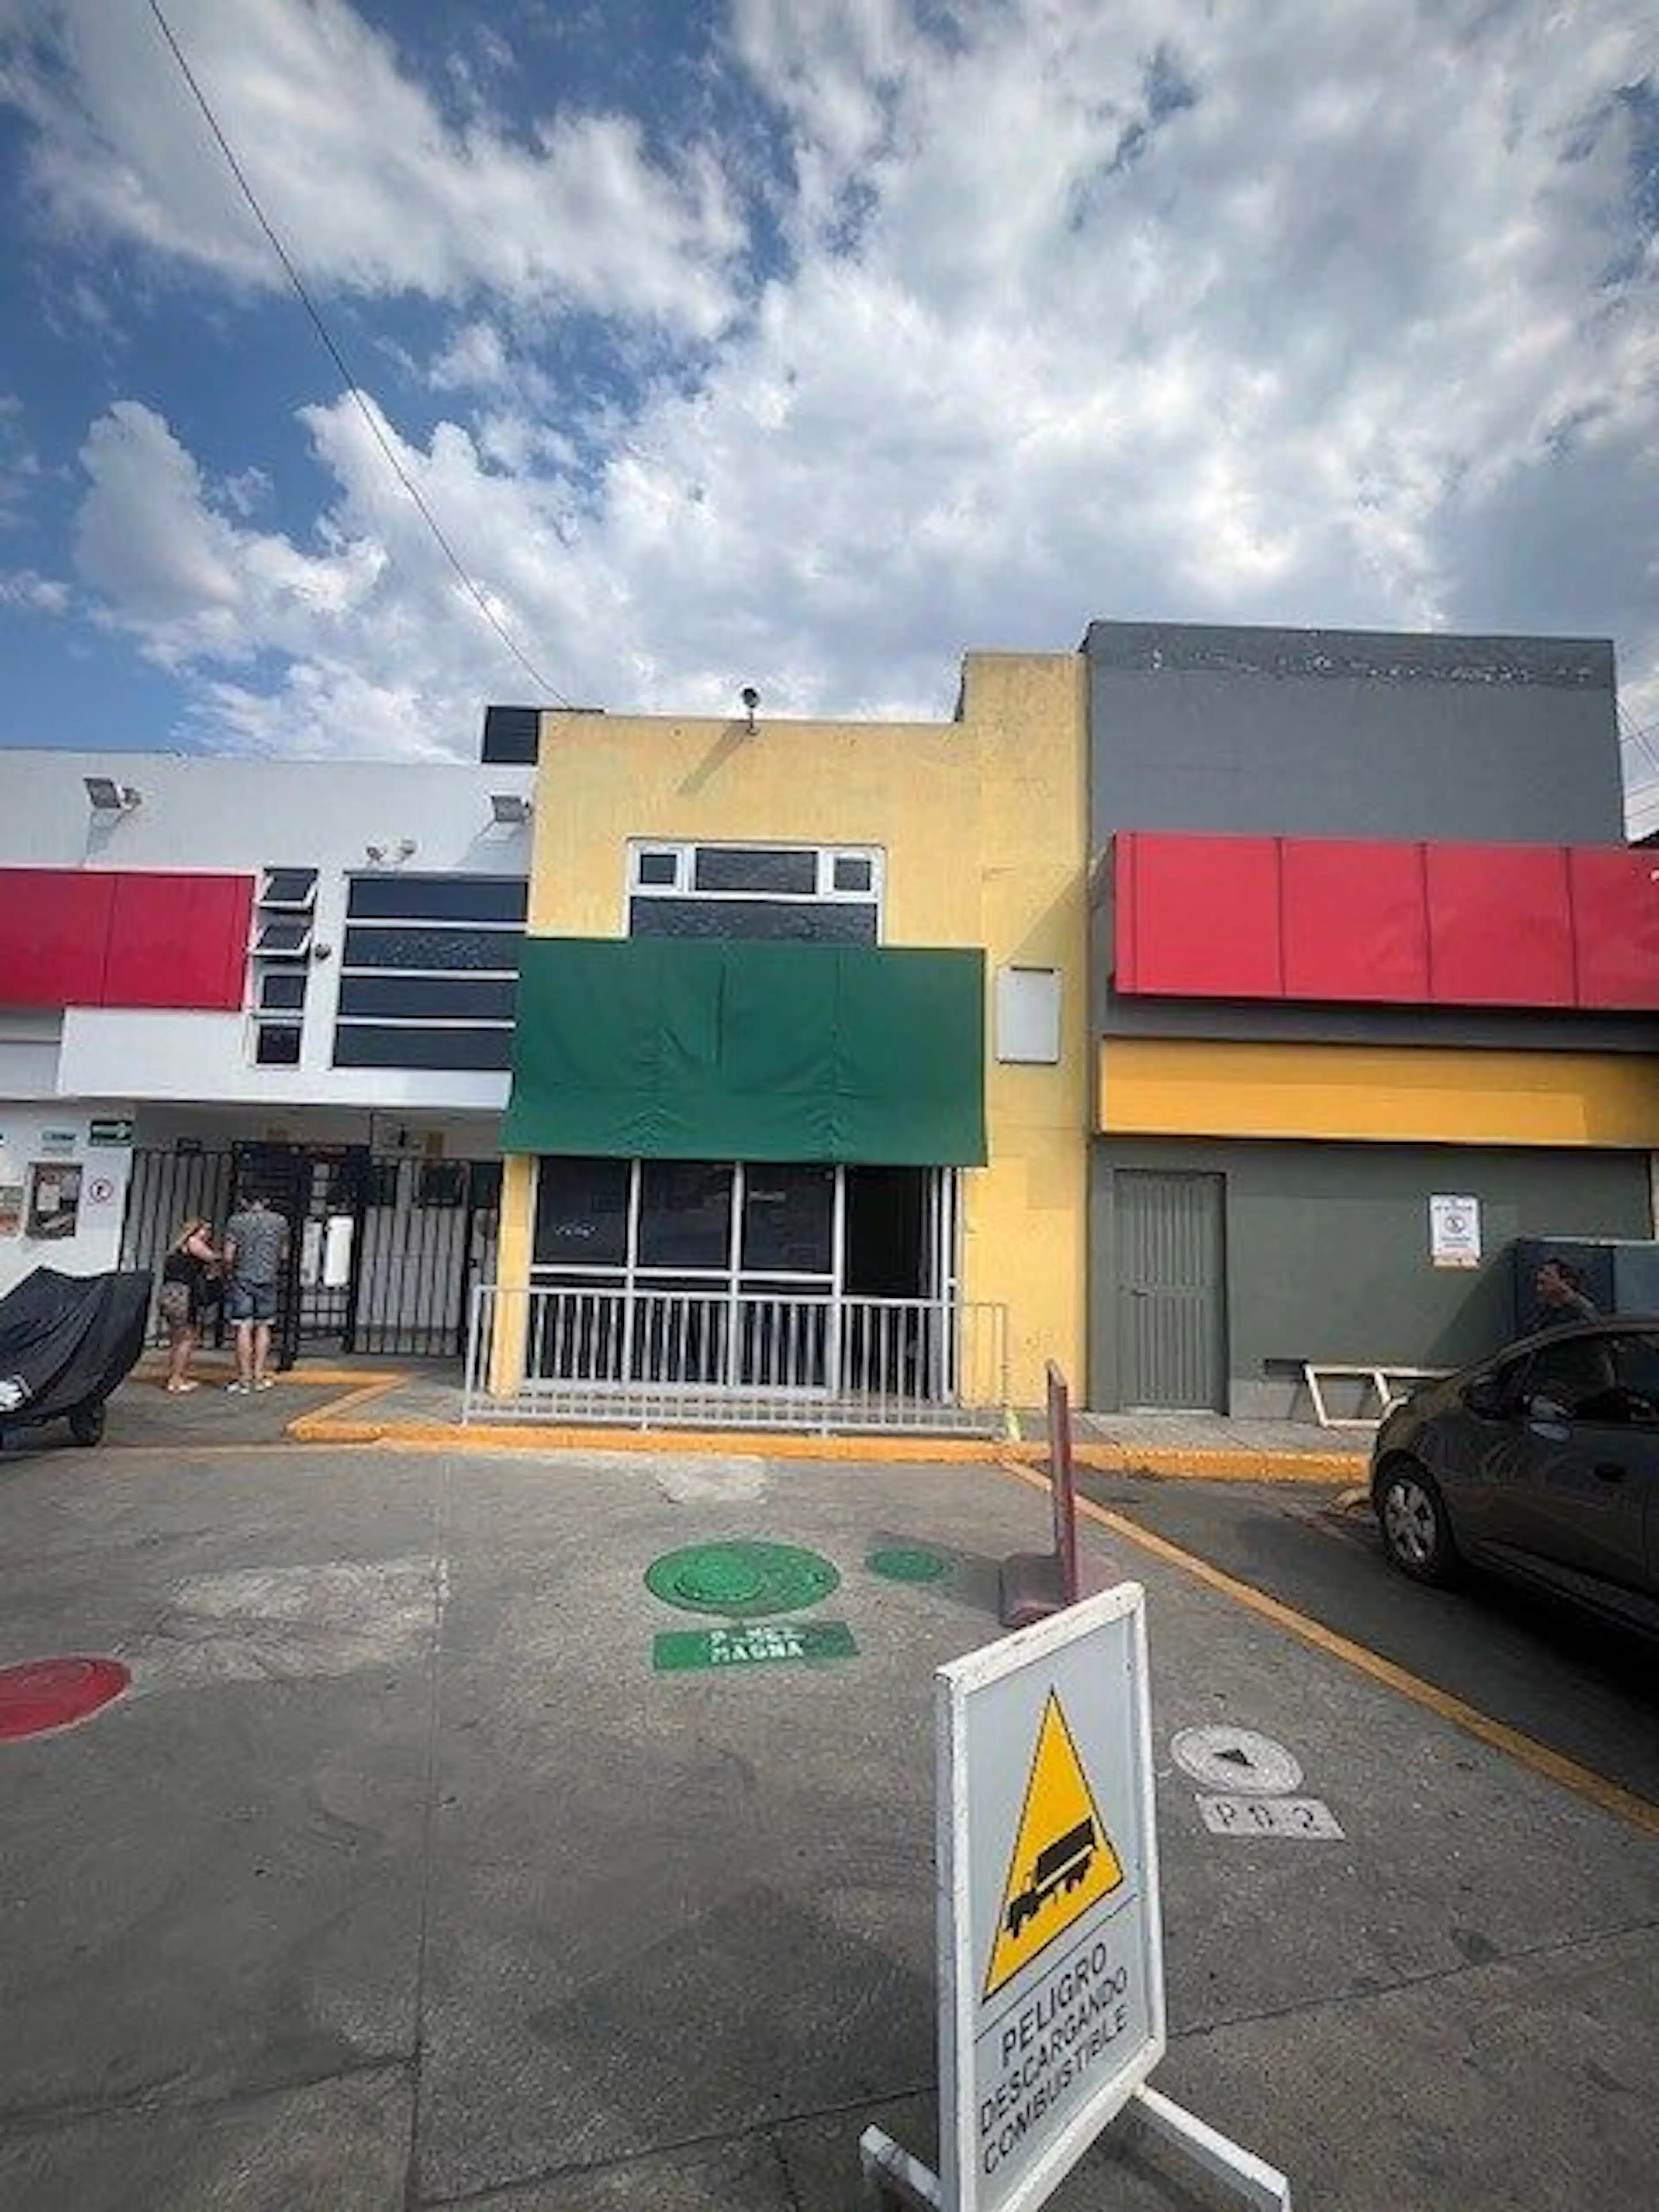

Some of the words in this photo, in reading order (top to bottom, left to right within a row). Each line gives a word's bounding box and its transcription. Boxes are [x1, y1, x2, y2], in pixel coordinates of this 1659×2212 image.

[981, 1966, 1127, 2136] DESCARGANDO
[985, 2004, 1127, 2174] COMBUSTIBLE
[1001, 1942, 1106, 2068] PELIGRO
